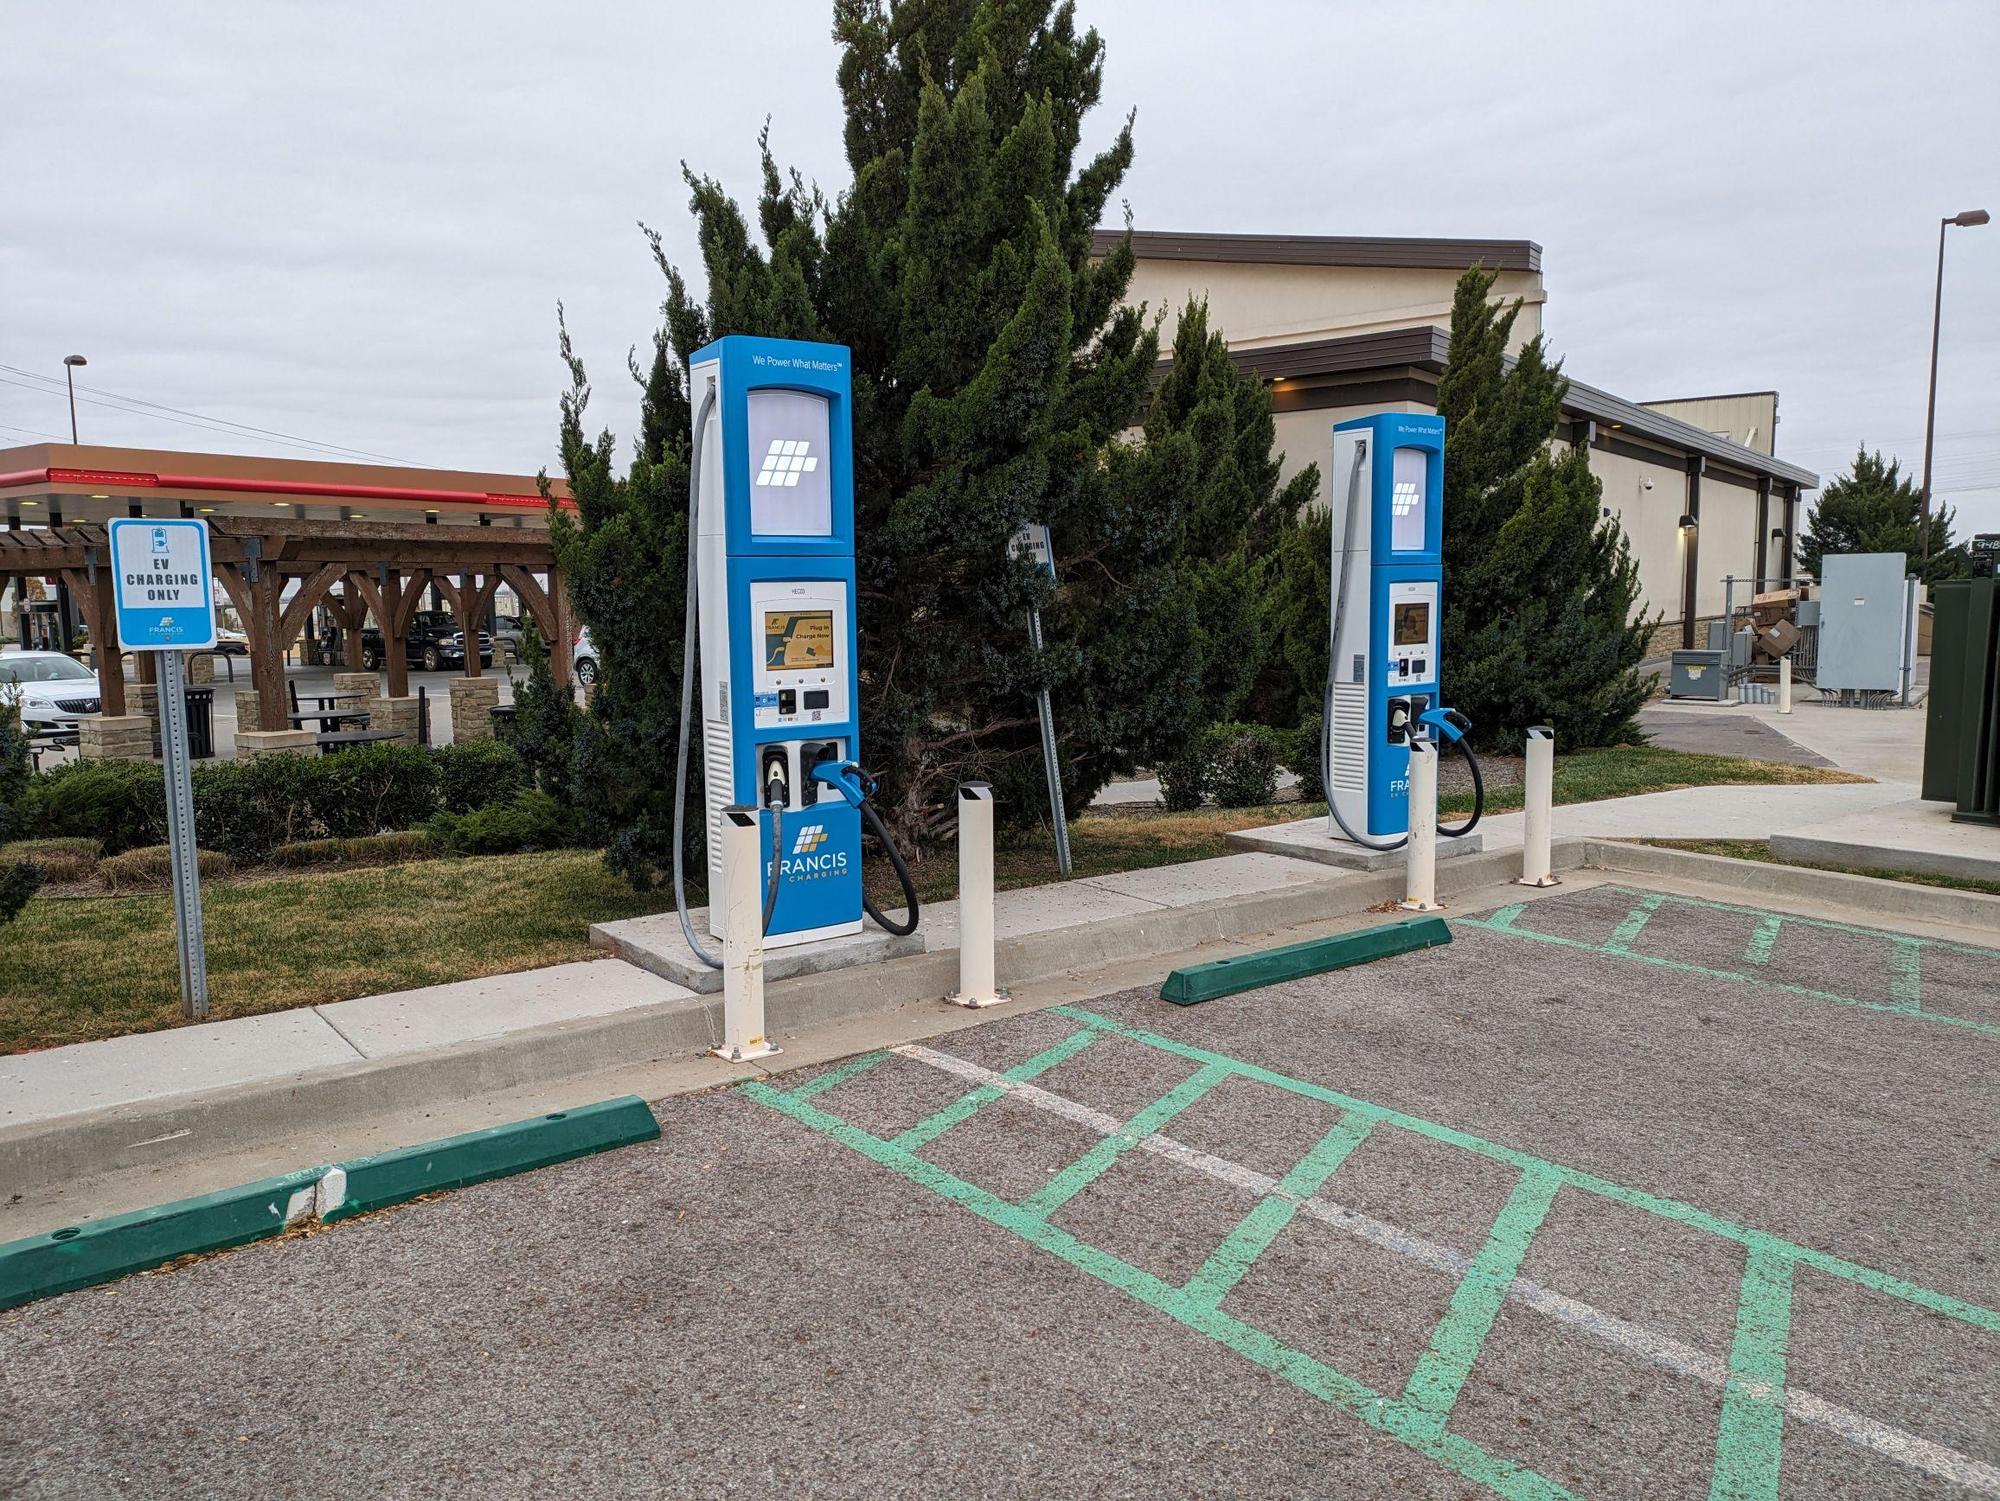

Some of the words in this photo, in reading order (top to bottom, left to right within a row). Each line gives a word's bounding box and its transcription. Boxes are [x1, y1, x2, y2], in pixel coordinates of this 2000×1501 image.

[752, 355, 766, 366] We
[767, 356, 791, 368] Power
[792, 358, 811, 370] What
[153, 558, 169, 570] EV
[126, 574, 198, 586] CHARGING
[147, 589, 180, 601] ONLY
[809, 624, 824, 632] Plug
[795, 633, 816, 642] Charge
[788, 868, 848, 882] CHARGING
